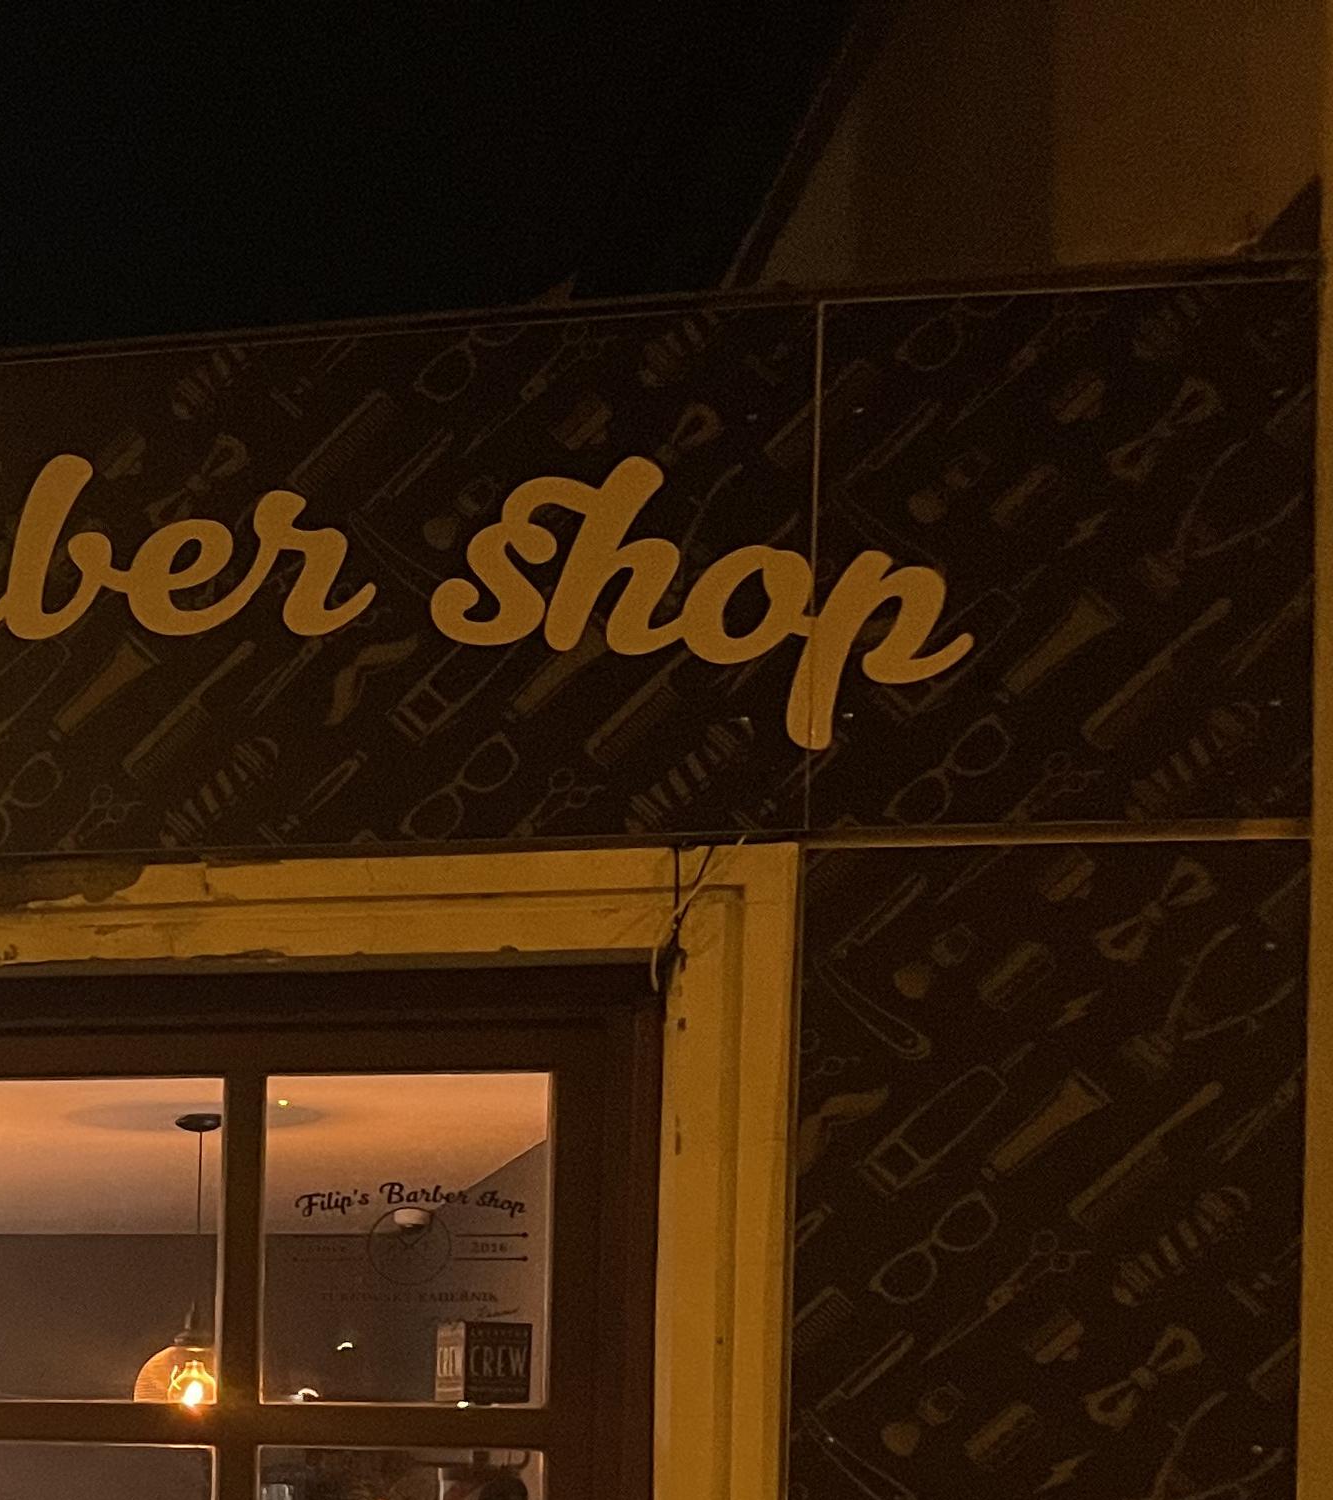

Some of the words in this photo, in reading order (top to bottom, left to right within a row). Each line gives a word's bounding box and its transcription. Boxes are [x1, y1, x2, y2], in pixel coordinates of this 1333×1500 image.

[294, 1188, 370, 1218] Filip's
[379, 1181, 470, 1207] Barber
[469, 1344, 528, 1380] CREW
